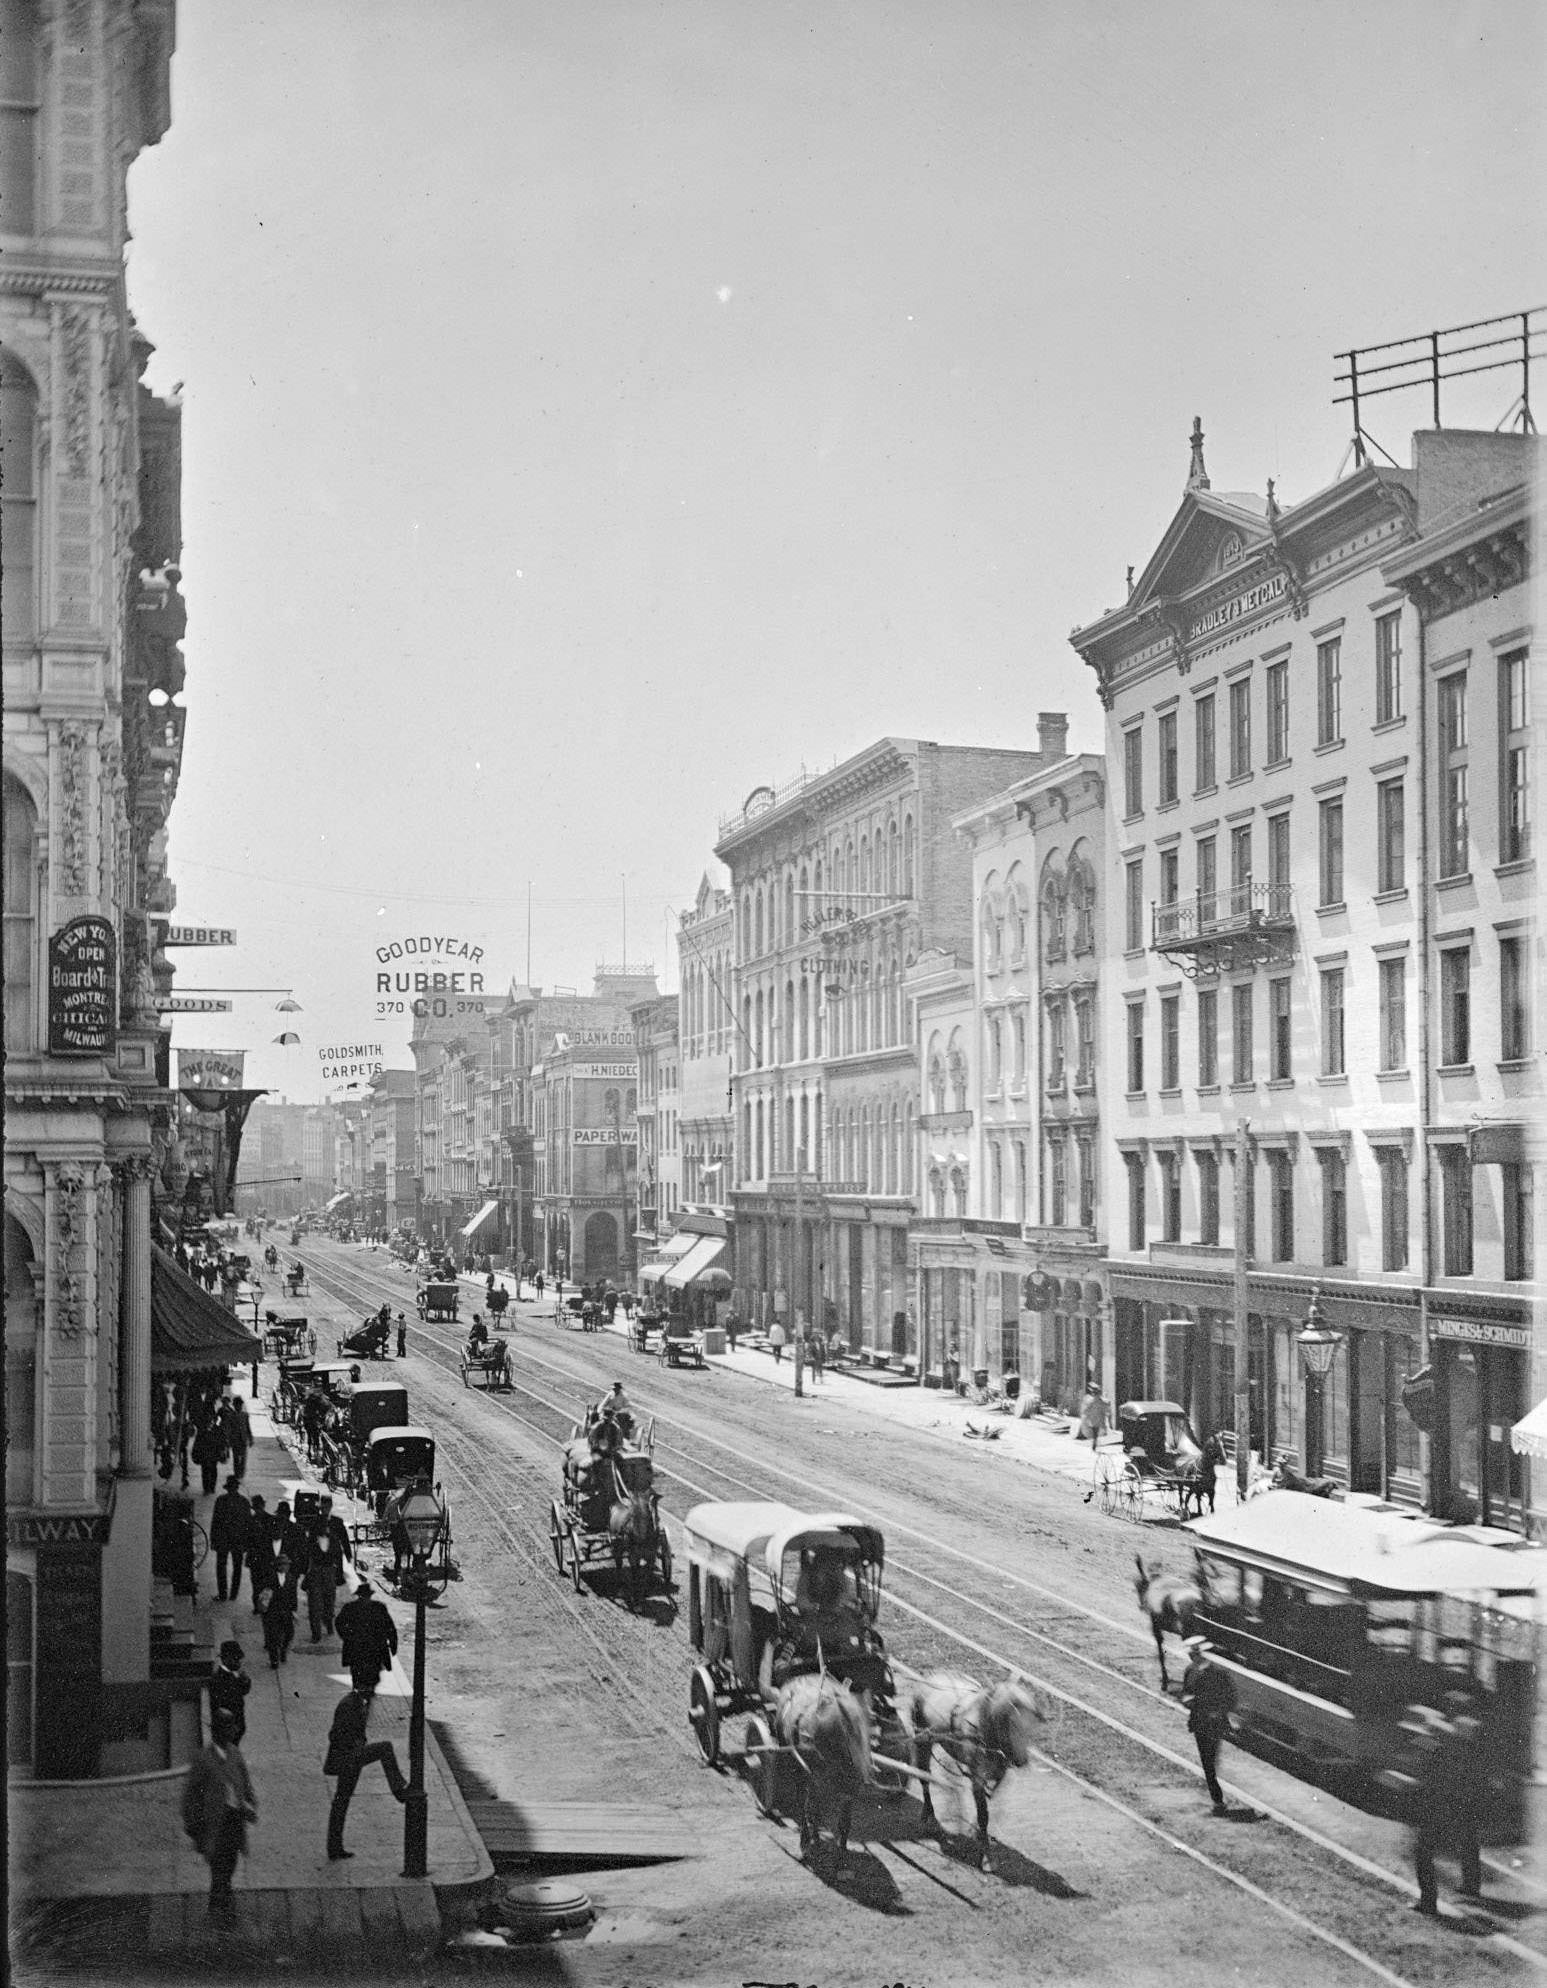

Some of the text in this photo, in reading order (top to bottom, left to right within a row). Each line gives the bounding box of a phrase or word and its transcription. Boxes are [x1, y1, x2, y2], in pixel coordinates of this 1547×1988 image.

[57, 926, 108, 955] NEW YO
[169, 929, 233, 944] UBBER
[78, 947, 105, 961] OPEN
[376, 936, 484, 964] GOODYEAR
[800, 958, 870, 976] CLOTHING
[53, 965, 92, 987] Board
[376, 972, 484, 993] RUBBER
[152, 999, 227, 1011] GOODS
[376, 998, 484, 1018] 370 CO. 370
[52, 1012, 106, 1025] CHICA
[180, 1060, 242, 1081] THE GREAT
[322, 1062, 383, 1079] CARPETS
[574, 1131, 618, 1142] PAPER
[771, 1183, 865, 1193] FUNITURE
